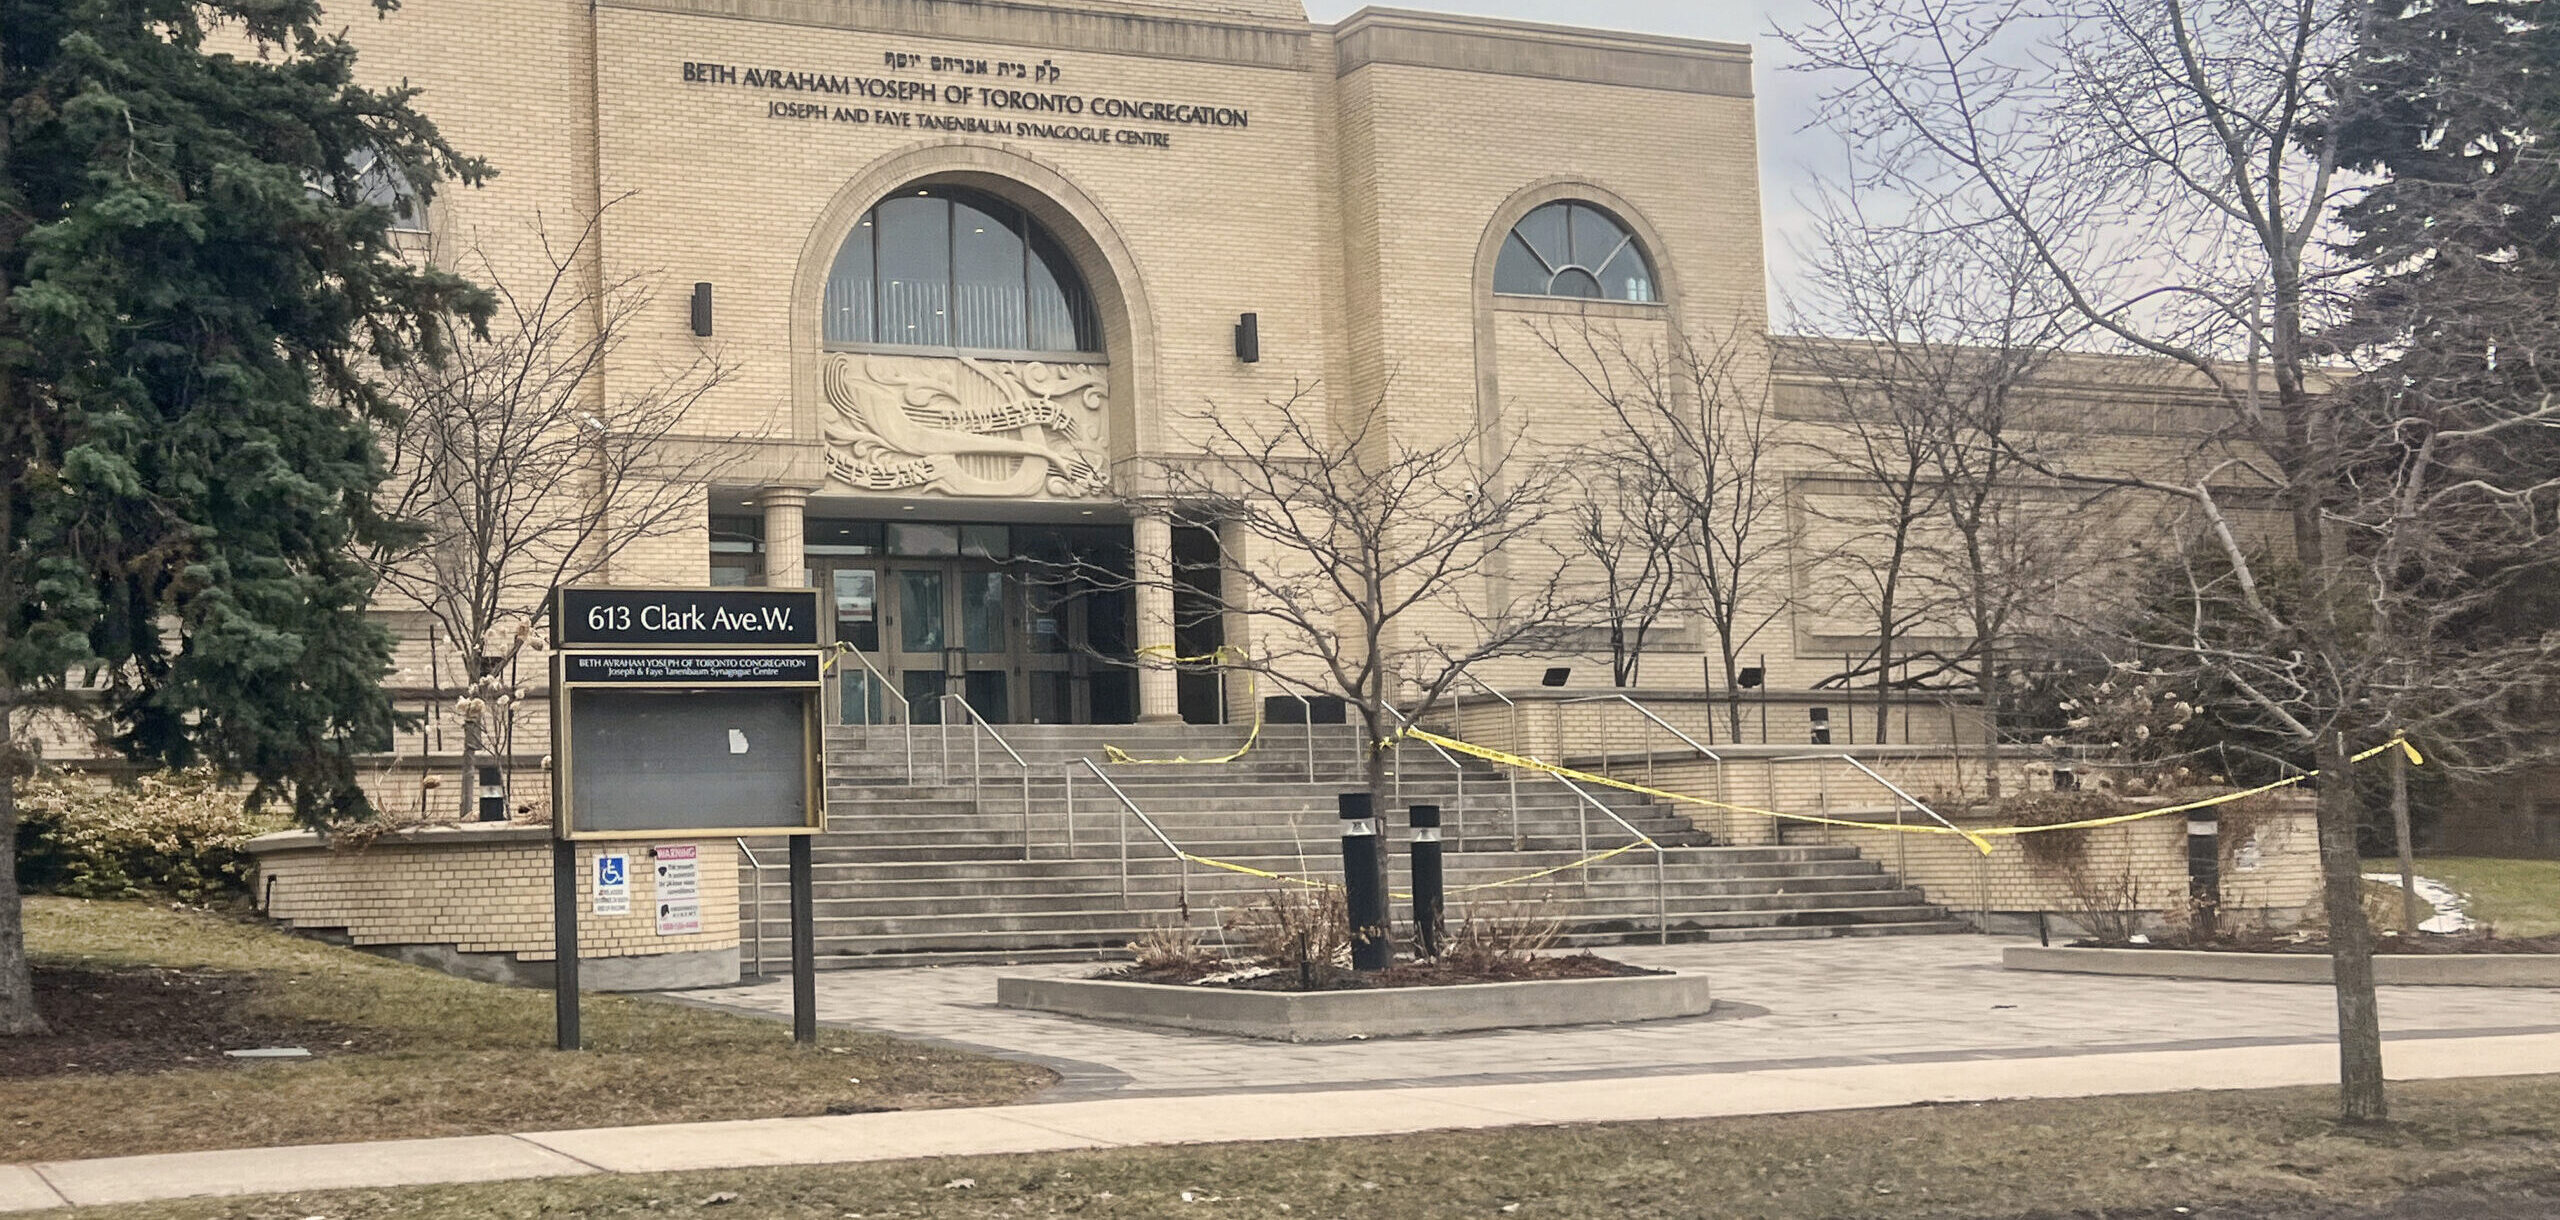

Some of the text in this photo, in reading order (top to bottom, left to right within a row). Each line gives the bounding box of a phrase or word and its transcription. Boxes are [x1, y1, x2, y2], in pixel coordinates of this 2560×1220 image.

[885, 51, 921, 72] יוסף
[930, 55, 988, 75] אברהם
[997, 61, 1027, 78] בית
[683, 62, 1248, 127] BETH AVRAHAM YOSEPH OF TORONTO CONGREGATION
[768, 101, 1170, 147] JOSEPH AND FAYE TANENBAUM SYNAGOGUE CENTRE
[588, 605, 631, 631] 613
[640, 604, 706, 632] Clark
[579, 658, 807, 668] BETH AVRAHAM YOSEPH OF TORONTO CONGREGATION
[608, 667, 779, 678] Joseph & Faye Tanenbaum Synagogue Centre
[656, 847, 695, 859] WARNING
